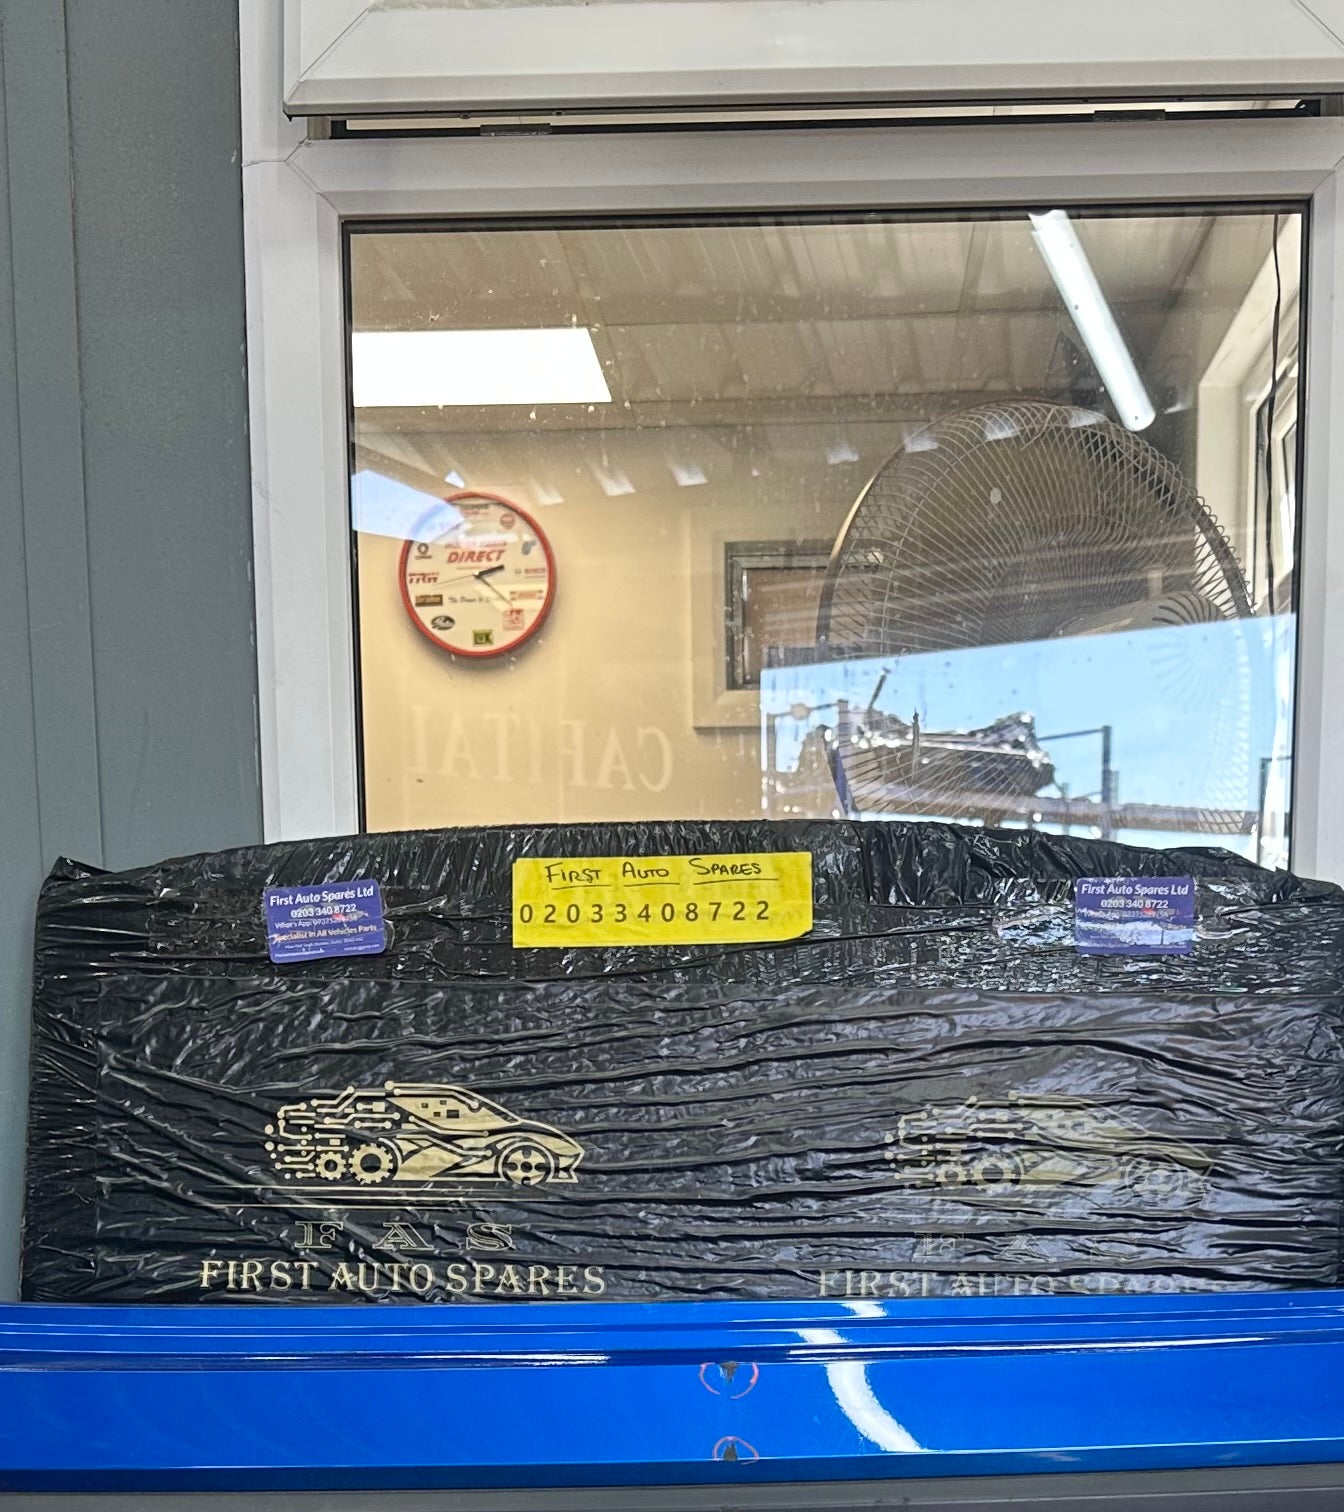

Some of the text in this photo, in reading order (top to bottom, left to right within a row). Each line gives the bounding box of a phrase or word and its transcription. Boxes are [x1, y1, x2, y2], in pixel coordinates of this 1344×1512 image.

[446, 549, 506, 564] DIRECT
[544, 857, 762, 884] FIRST AUTO SPARES
[270, 885, 374, 907] First Auto Spares Ltd
[1081, 884, 1190, 896] First Auto Spares Ltd
[290, 903, 357, 918] 0203 340 8722
[519, 900, 770, 924] 02033408722
[1100, 899, 1169, 909] 0203 340 8722
[200, 1260, 607, 1296] FIRST AUTO SPARES
[817, 1269, 940, 1298] FIRST
